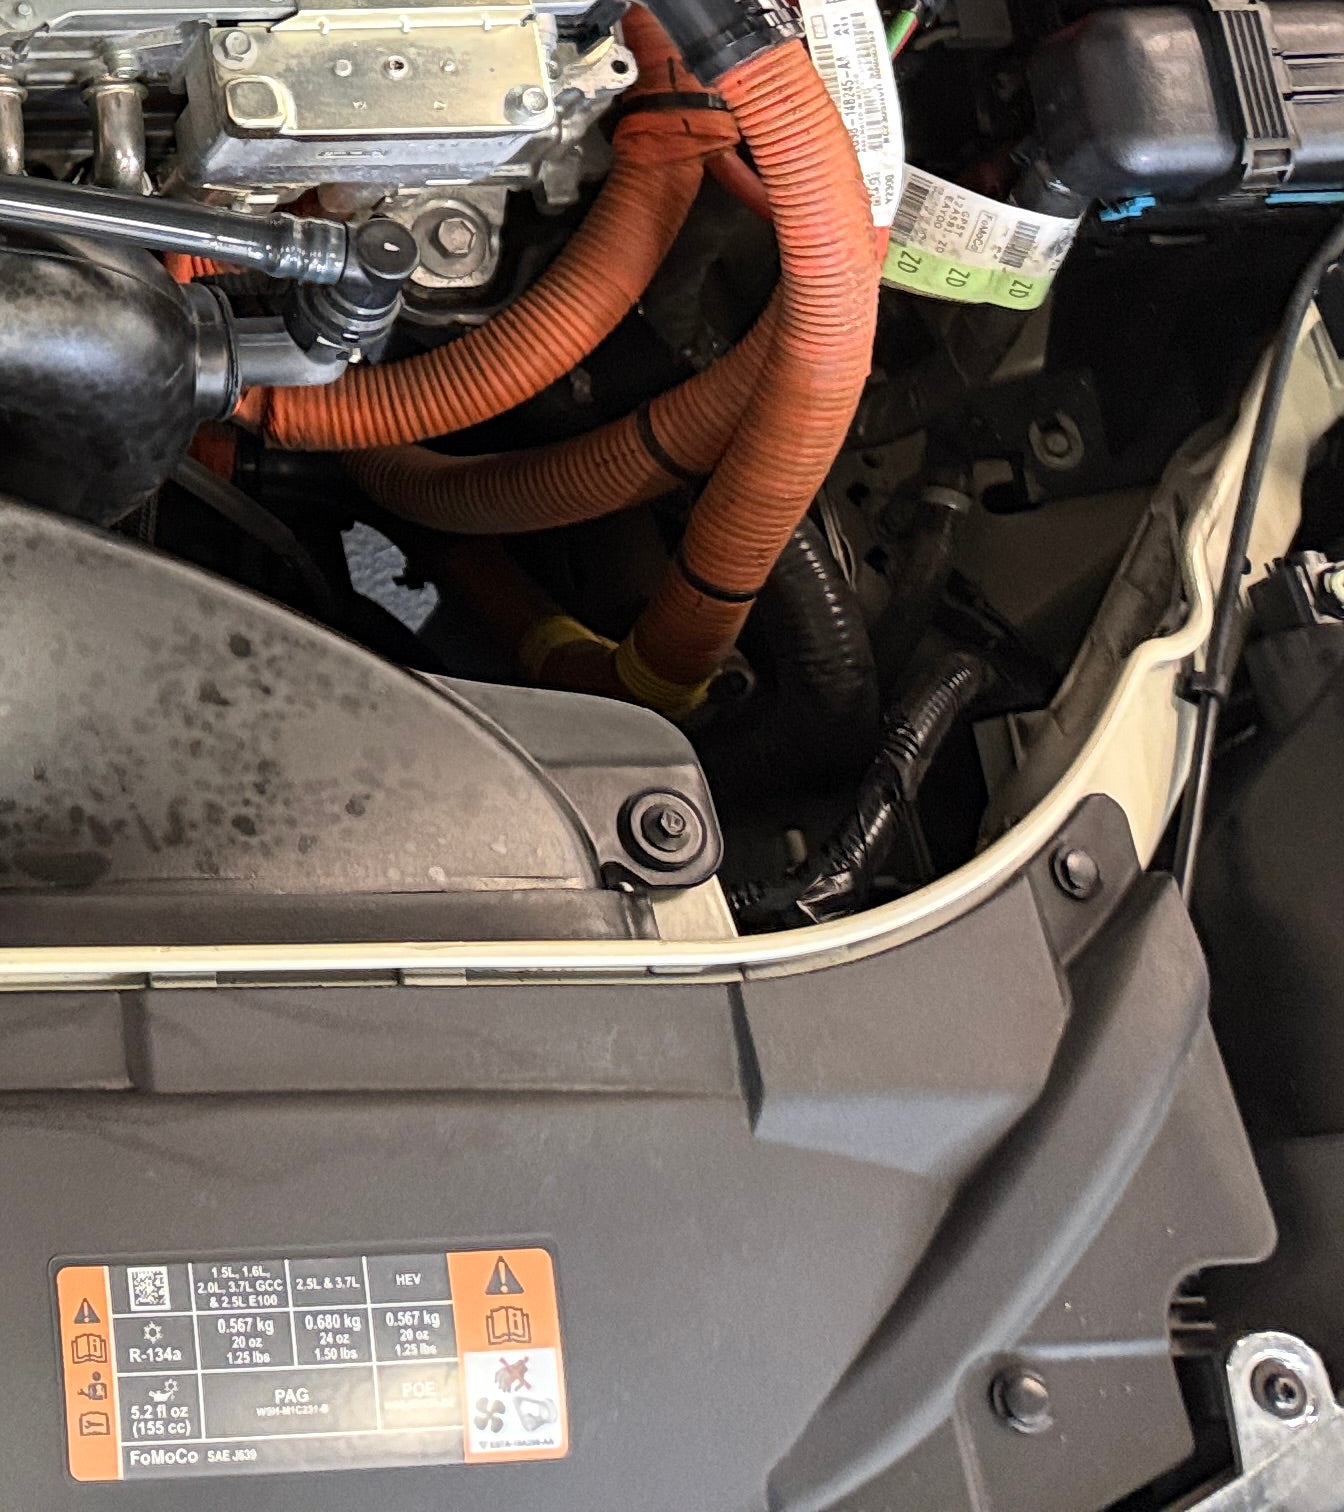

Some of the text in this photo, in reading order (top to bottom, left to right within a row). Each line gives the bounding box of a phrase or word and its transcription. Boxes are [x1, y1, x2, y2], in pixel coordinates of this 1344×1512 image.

[897, 250, 923, 274] ZD
[946, 268, 971, 287] ZD
[1008, 280, 1033, 298] ZD
[212, 1266, 270, 1278] 1.5L, 1.6L,
[197, 1279, 283, 1294] 2.0L, 3.7L GCC
[296, 1276, 360, 1291] 2.5L & 3.7L
[396, 1274, 422, 1286] HEV
[210, 1295, 278, 1308] & 2.5L E100
[217, 1317, 274, 1336] 0.567 kg
[305, 1313, 362, 1331] 0.680 kg
[385, 1310, 440, 1328] 0.567 kg
[232, 1336, 263, 1349] 20 oz
[320, 1332, 350, 1344] 24 oz
[399, 1329, 429, 1341] 20 oz
[129, 1347, 182, 1362] R-134a
[227, 1351, 270, 1364] 1.25 lbs
[314, 1347, 358, 1361] 1.50 lbs
[395, 1343, 437, 1357] 1.25 lbs
[274, 1388, 310, 1404] PAG
[401, 1382, 437, 1398] POE
[131, 1404, 188, 1419] 5.2 fl oz
[133, 1420, 191, 1438] (155 cc)
[130, 1448, 257, 1465] FoMoCo SAE J639
